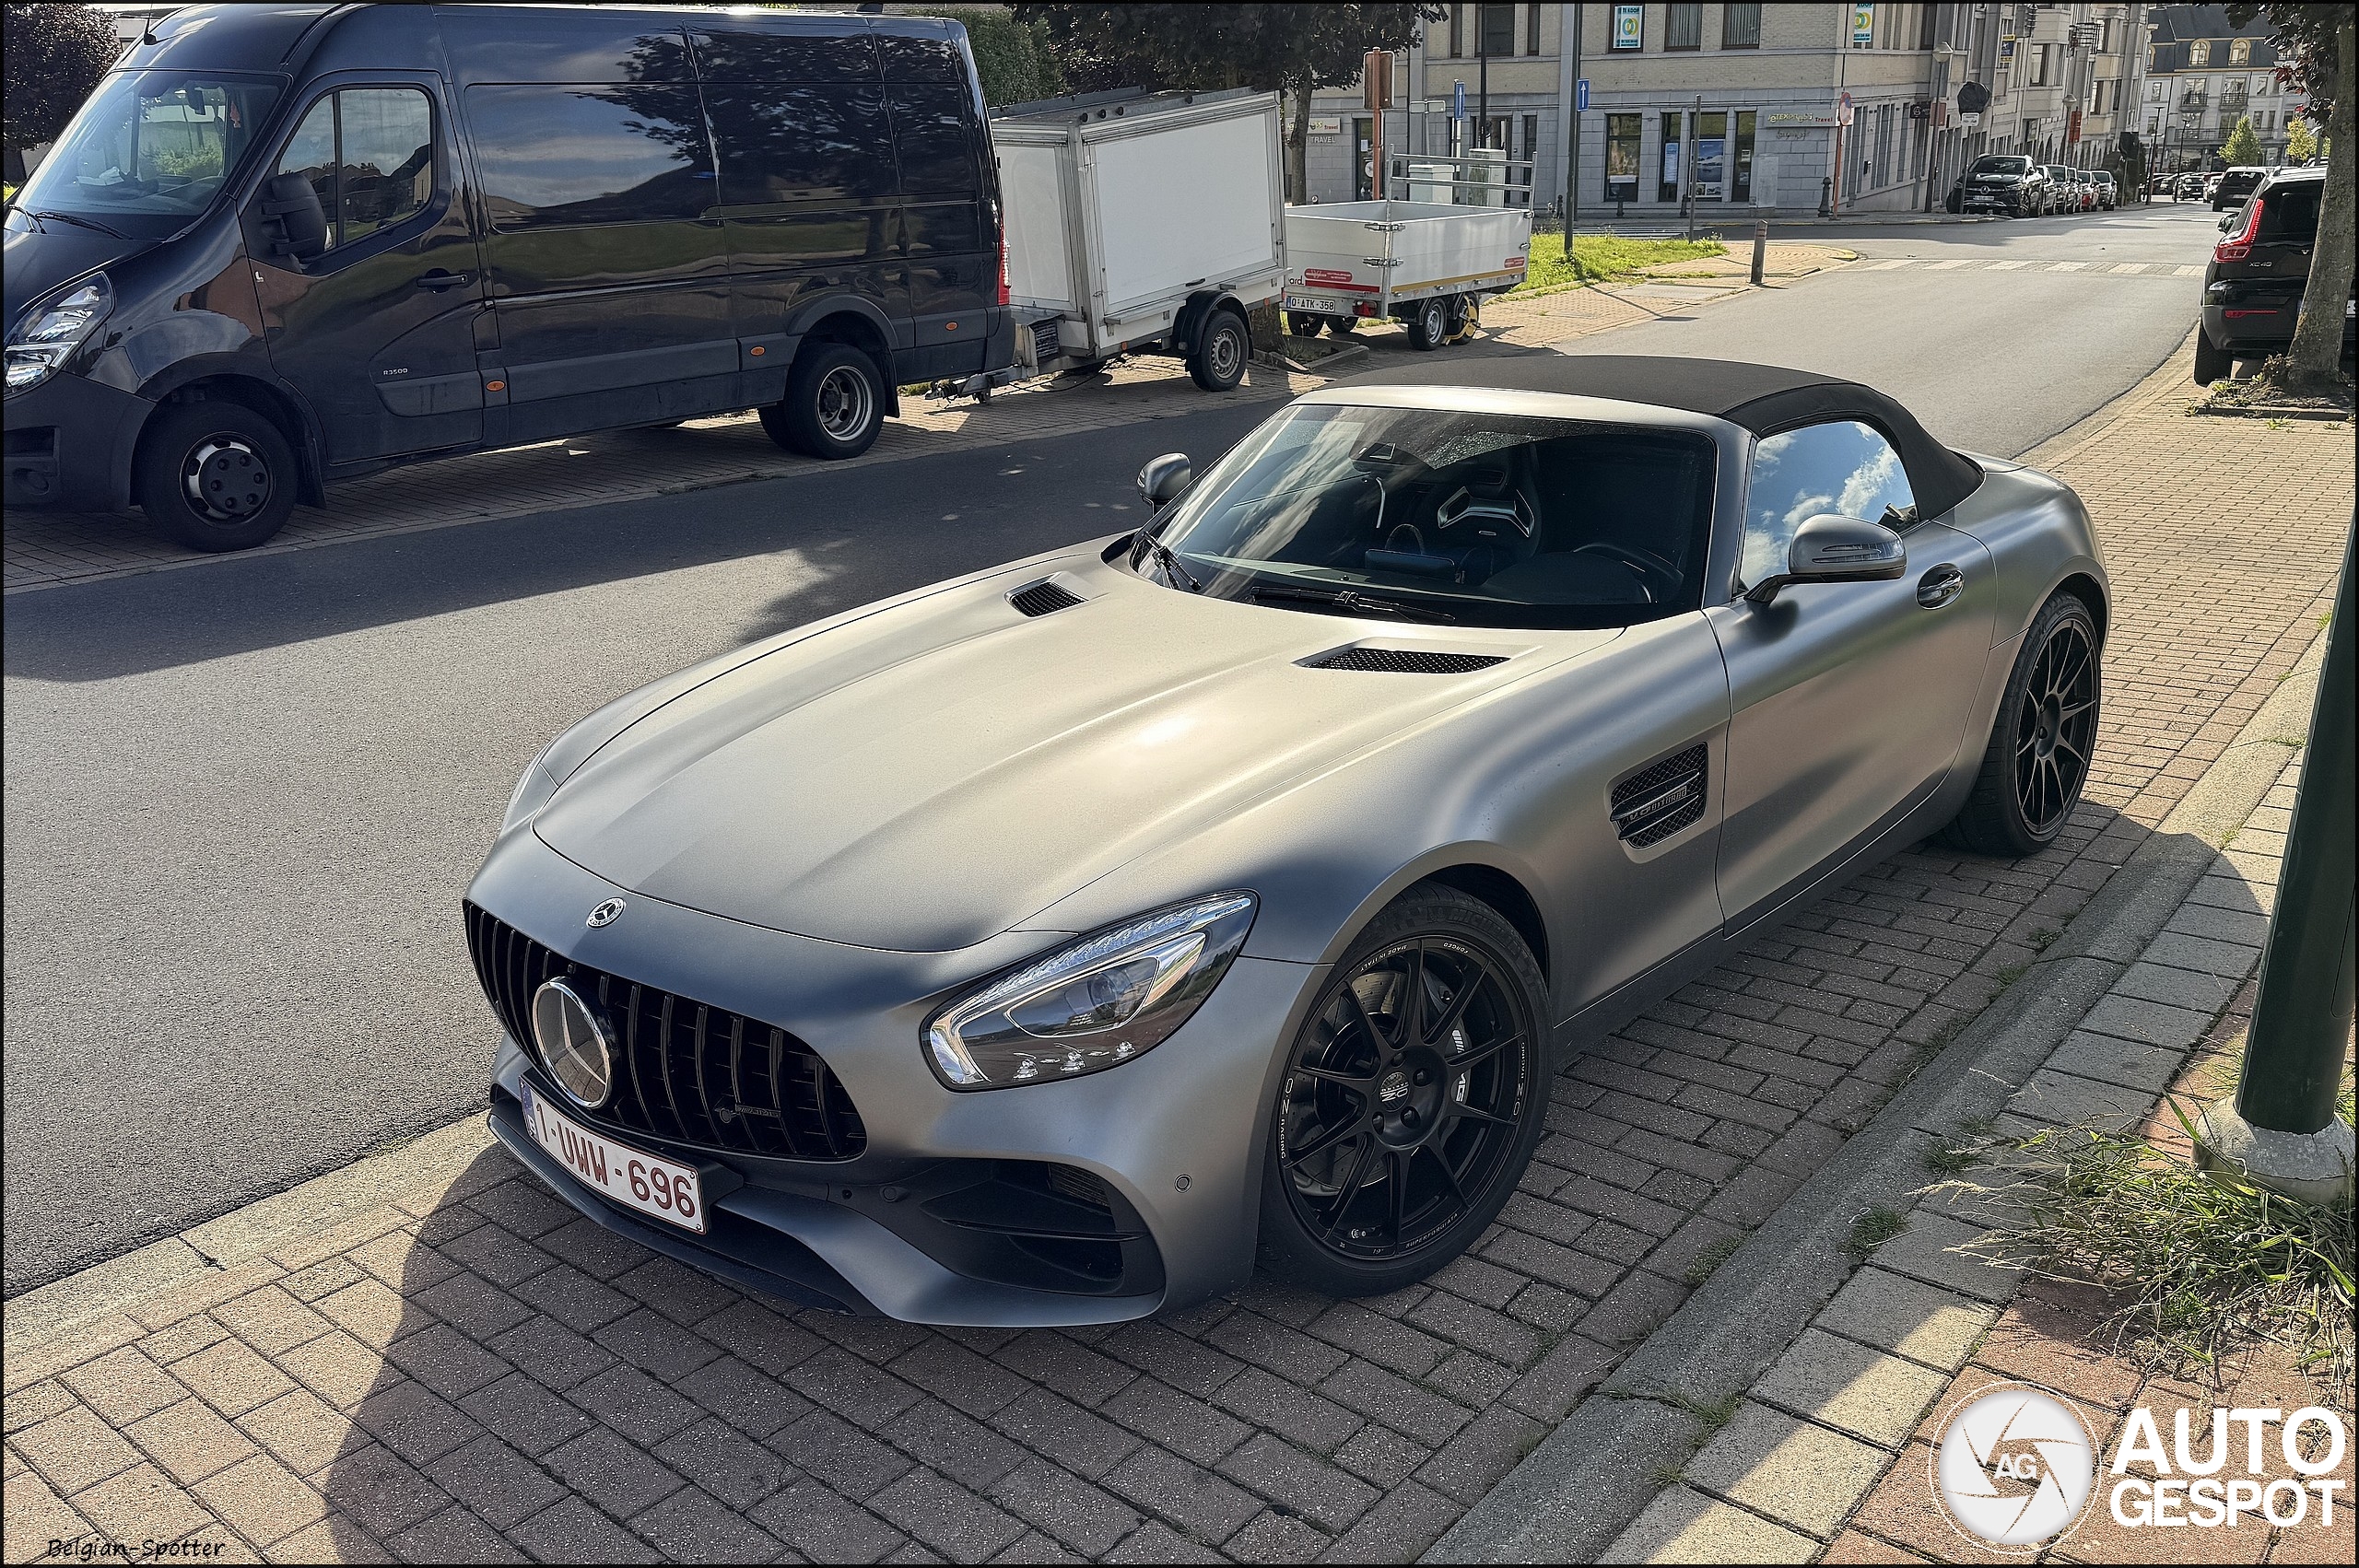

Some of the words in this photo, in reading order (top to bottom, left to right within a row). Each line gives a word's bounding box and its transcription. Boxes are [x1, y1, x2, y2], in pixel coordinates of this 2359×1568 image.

[1388, 944, 1408, 955] MADE
[1443, 942, 1469, 954] FORGED
[1379, 952, 1387, 960] IN
[1360, 956, 1379, 972] ITALY
[535, 1103, 696, 1218] 1-UWW-696
[1405, 1212, 1458, 1248] SUPERFORGIATA
